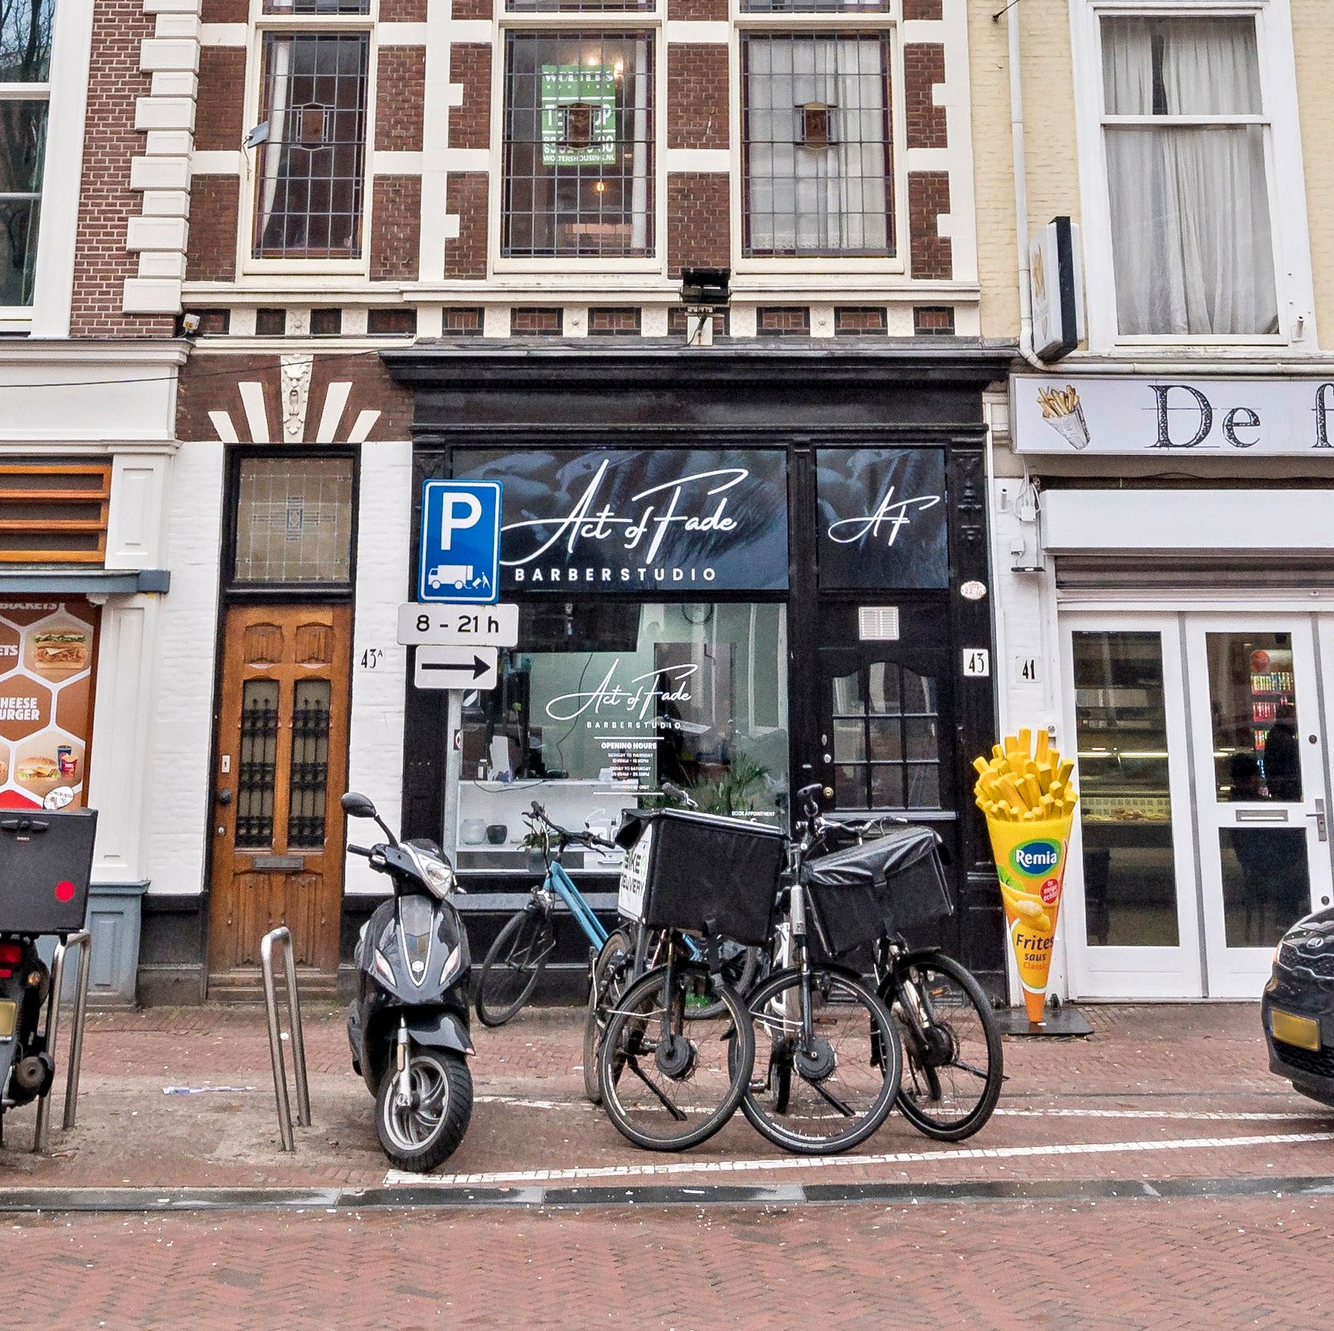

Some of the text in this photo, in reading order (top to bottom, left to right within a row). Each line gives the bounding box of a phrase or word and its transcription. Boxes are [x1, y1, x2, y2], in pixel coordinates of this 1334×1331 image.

[543, 154, 615, 162] WOTERSHOUSIN.NL
[1147, 383, 1262, 449] De
[440, 492, 482, 550] P
[500, 459, 749, 565] Act of Fade
[515, 568, 716, 581] BARBERSTUDIO
[416, 614, 430, 632] 8
[457, 615, 479, 633] 21
[487, 615, 499, 633] h
[968, 653, 985, 673] 43
[1022, 660, 1035, 679] 41
[546, 658, 698, 720] Act of Fade
[587, 721, 682, 729] BARBERSTUDIO
[1015, 849, 1057, 867] Remia
[1016, 933, 1054, 950] Frites
[1024, 953, 1046, 961] saus
